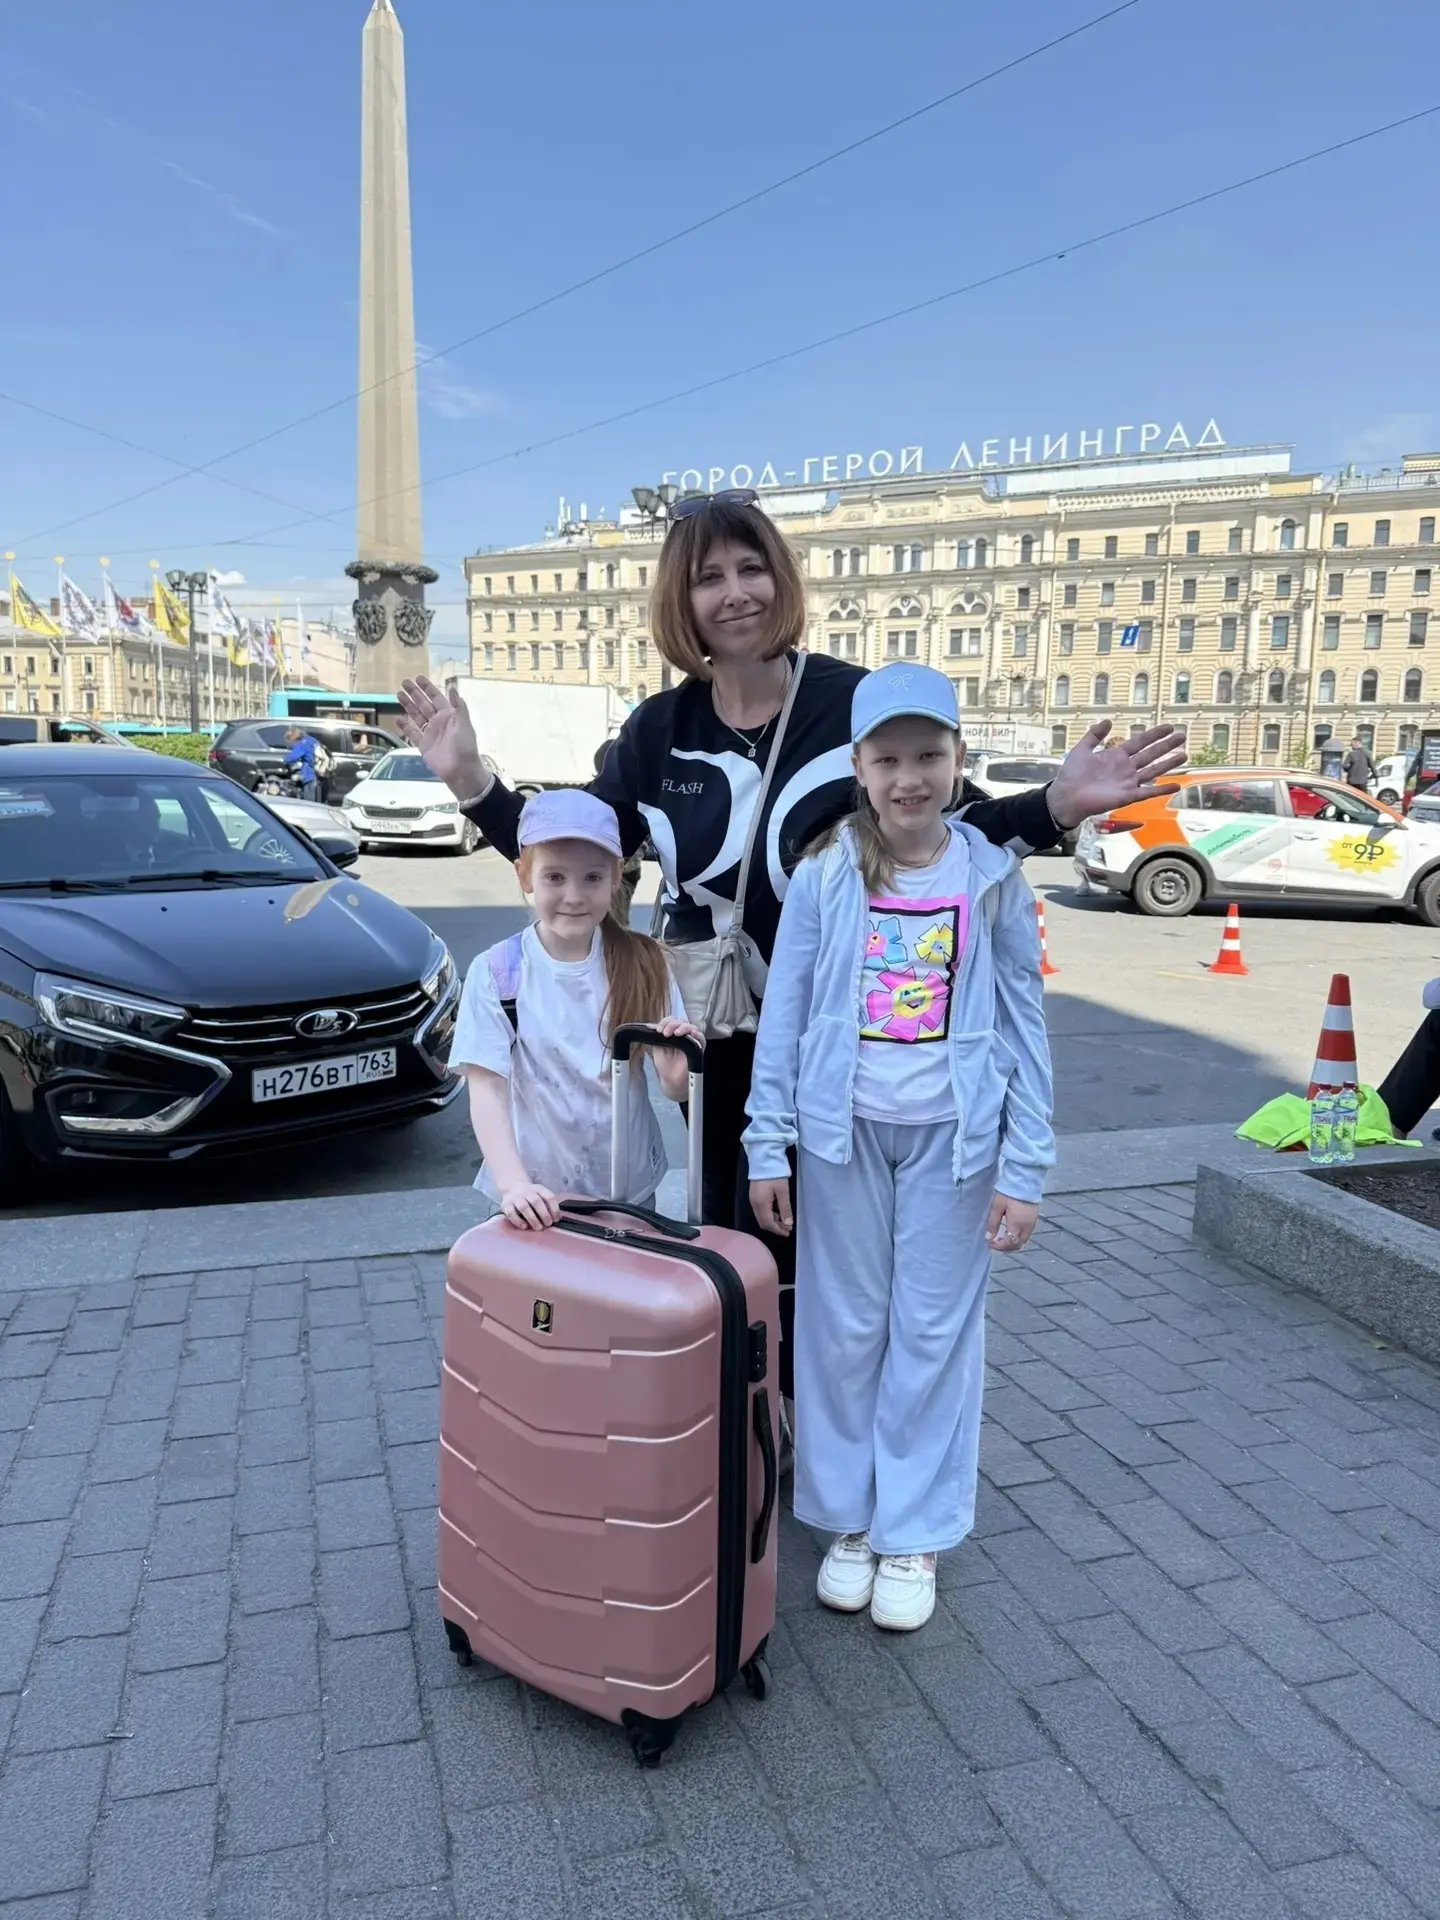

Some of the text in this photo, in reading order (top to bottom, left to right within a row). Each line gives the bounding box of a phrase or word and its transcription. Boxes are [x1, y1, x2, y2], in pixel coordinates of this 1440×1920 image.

[950, 416, 1227, 470] ЛЕНИНГРАД
[661, 778, 704, 795] FLASH
[359, 1051, 391, 1073] 763
[366, 1069, 383, 1079] RUS
